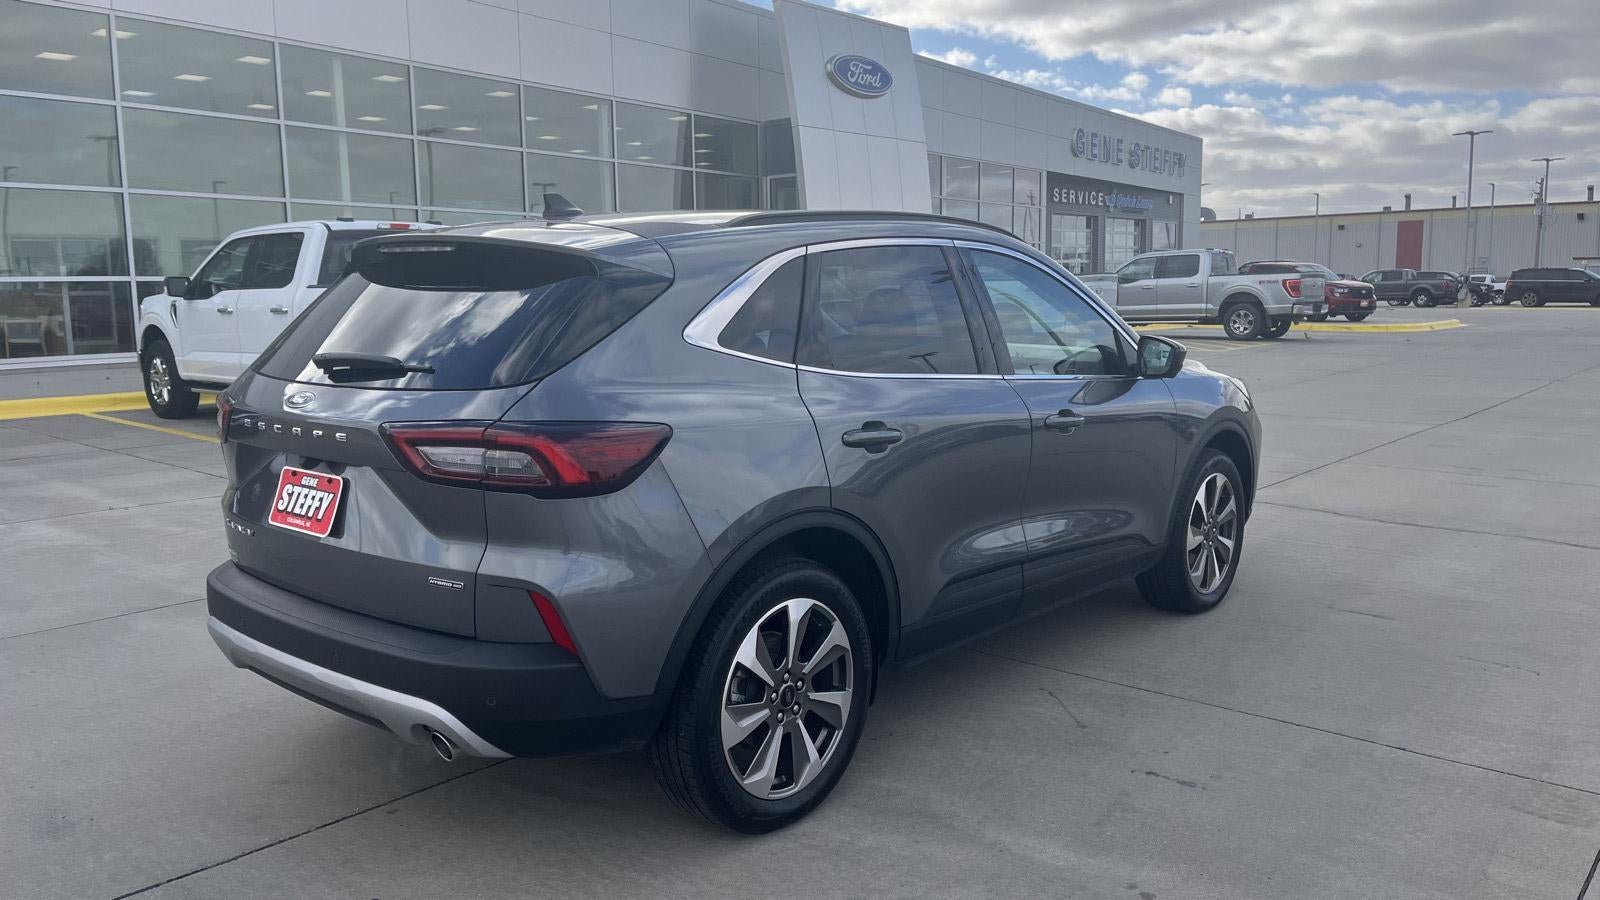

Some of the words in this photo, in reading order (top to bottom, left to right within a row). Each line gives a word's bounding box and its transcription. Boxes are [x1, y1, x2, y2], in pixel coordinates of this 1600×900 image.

[847, 61, 882, 88] Ford
[1071, 127, 1124, 166] GENE
[1128, 142, 1187, 178] STEFFY
[1053, 187, 1104, 206] SERVICE
[244, 418, 347, 442] ESCAPE
[301, 475, 319, 488] GENE
[277, 483, 335, 520] STEFFY
